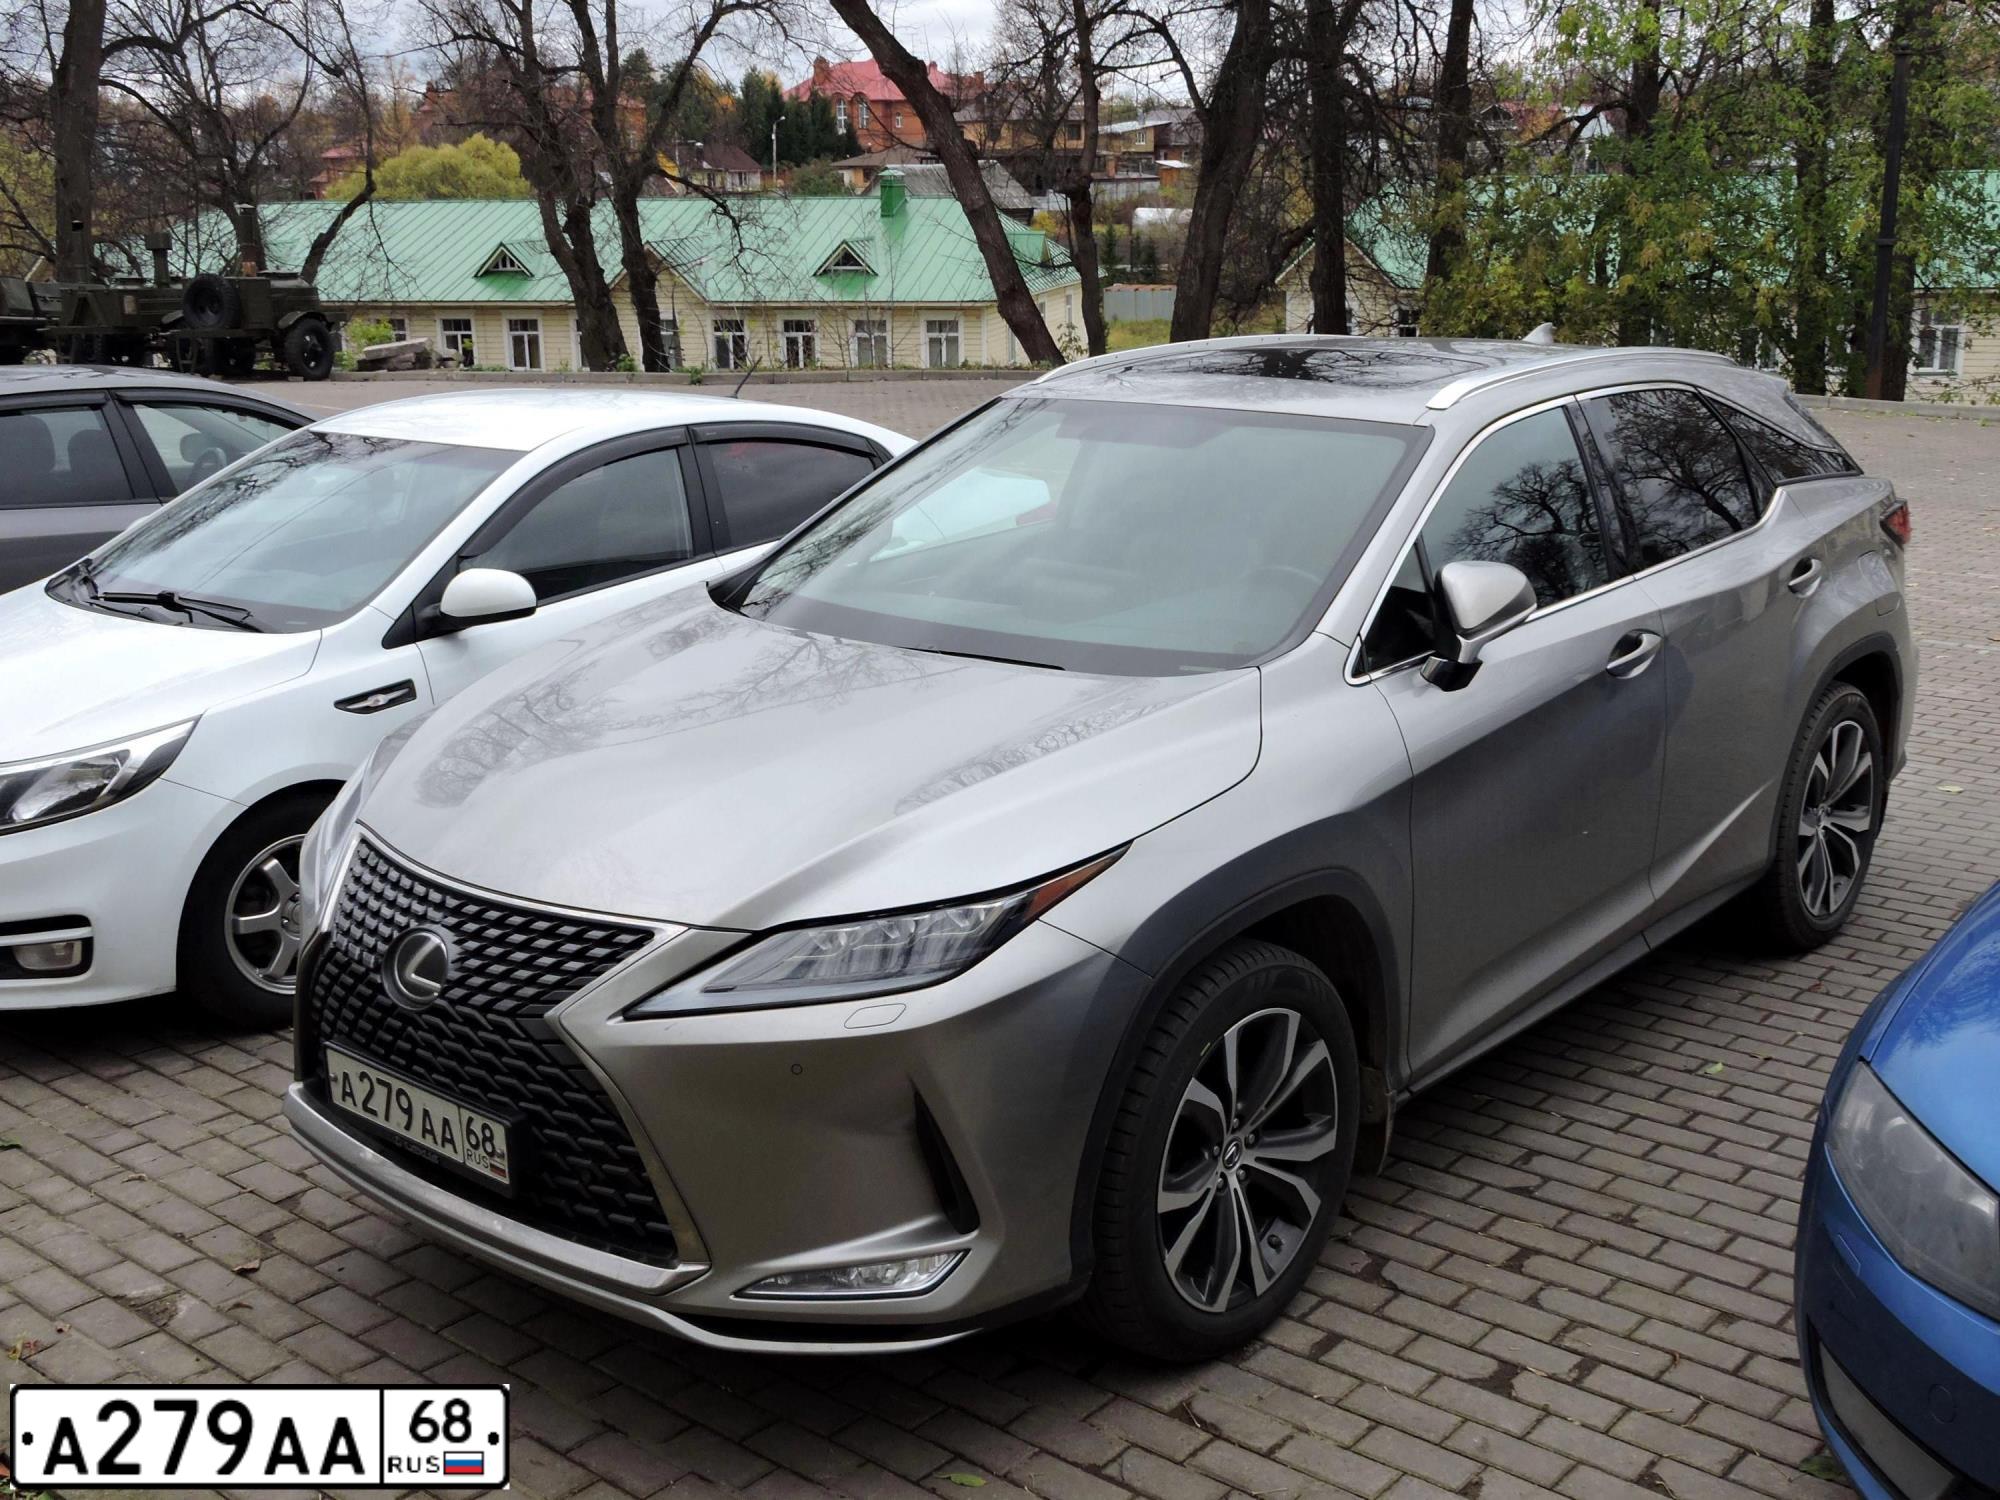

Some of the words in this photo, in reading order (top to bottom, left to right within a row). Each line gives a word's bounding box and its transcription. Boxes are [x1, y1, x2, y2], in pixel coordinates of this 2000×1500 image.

[341, 1071, 458, 1154] A279AA
[465, 1115, 497, 1157] 68
[466, 1149, 490, 1169] RUS
